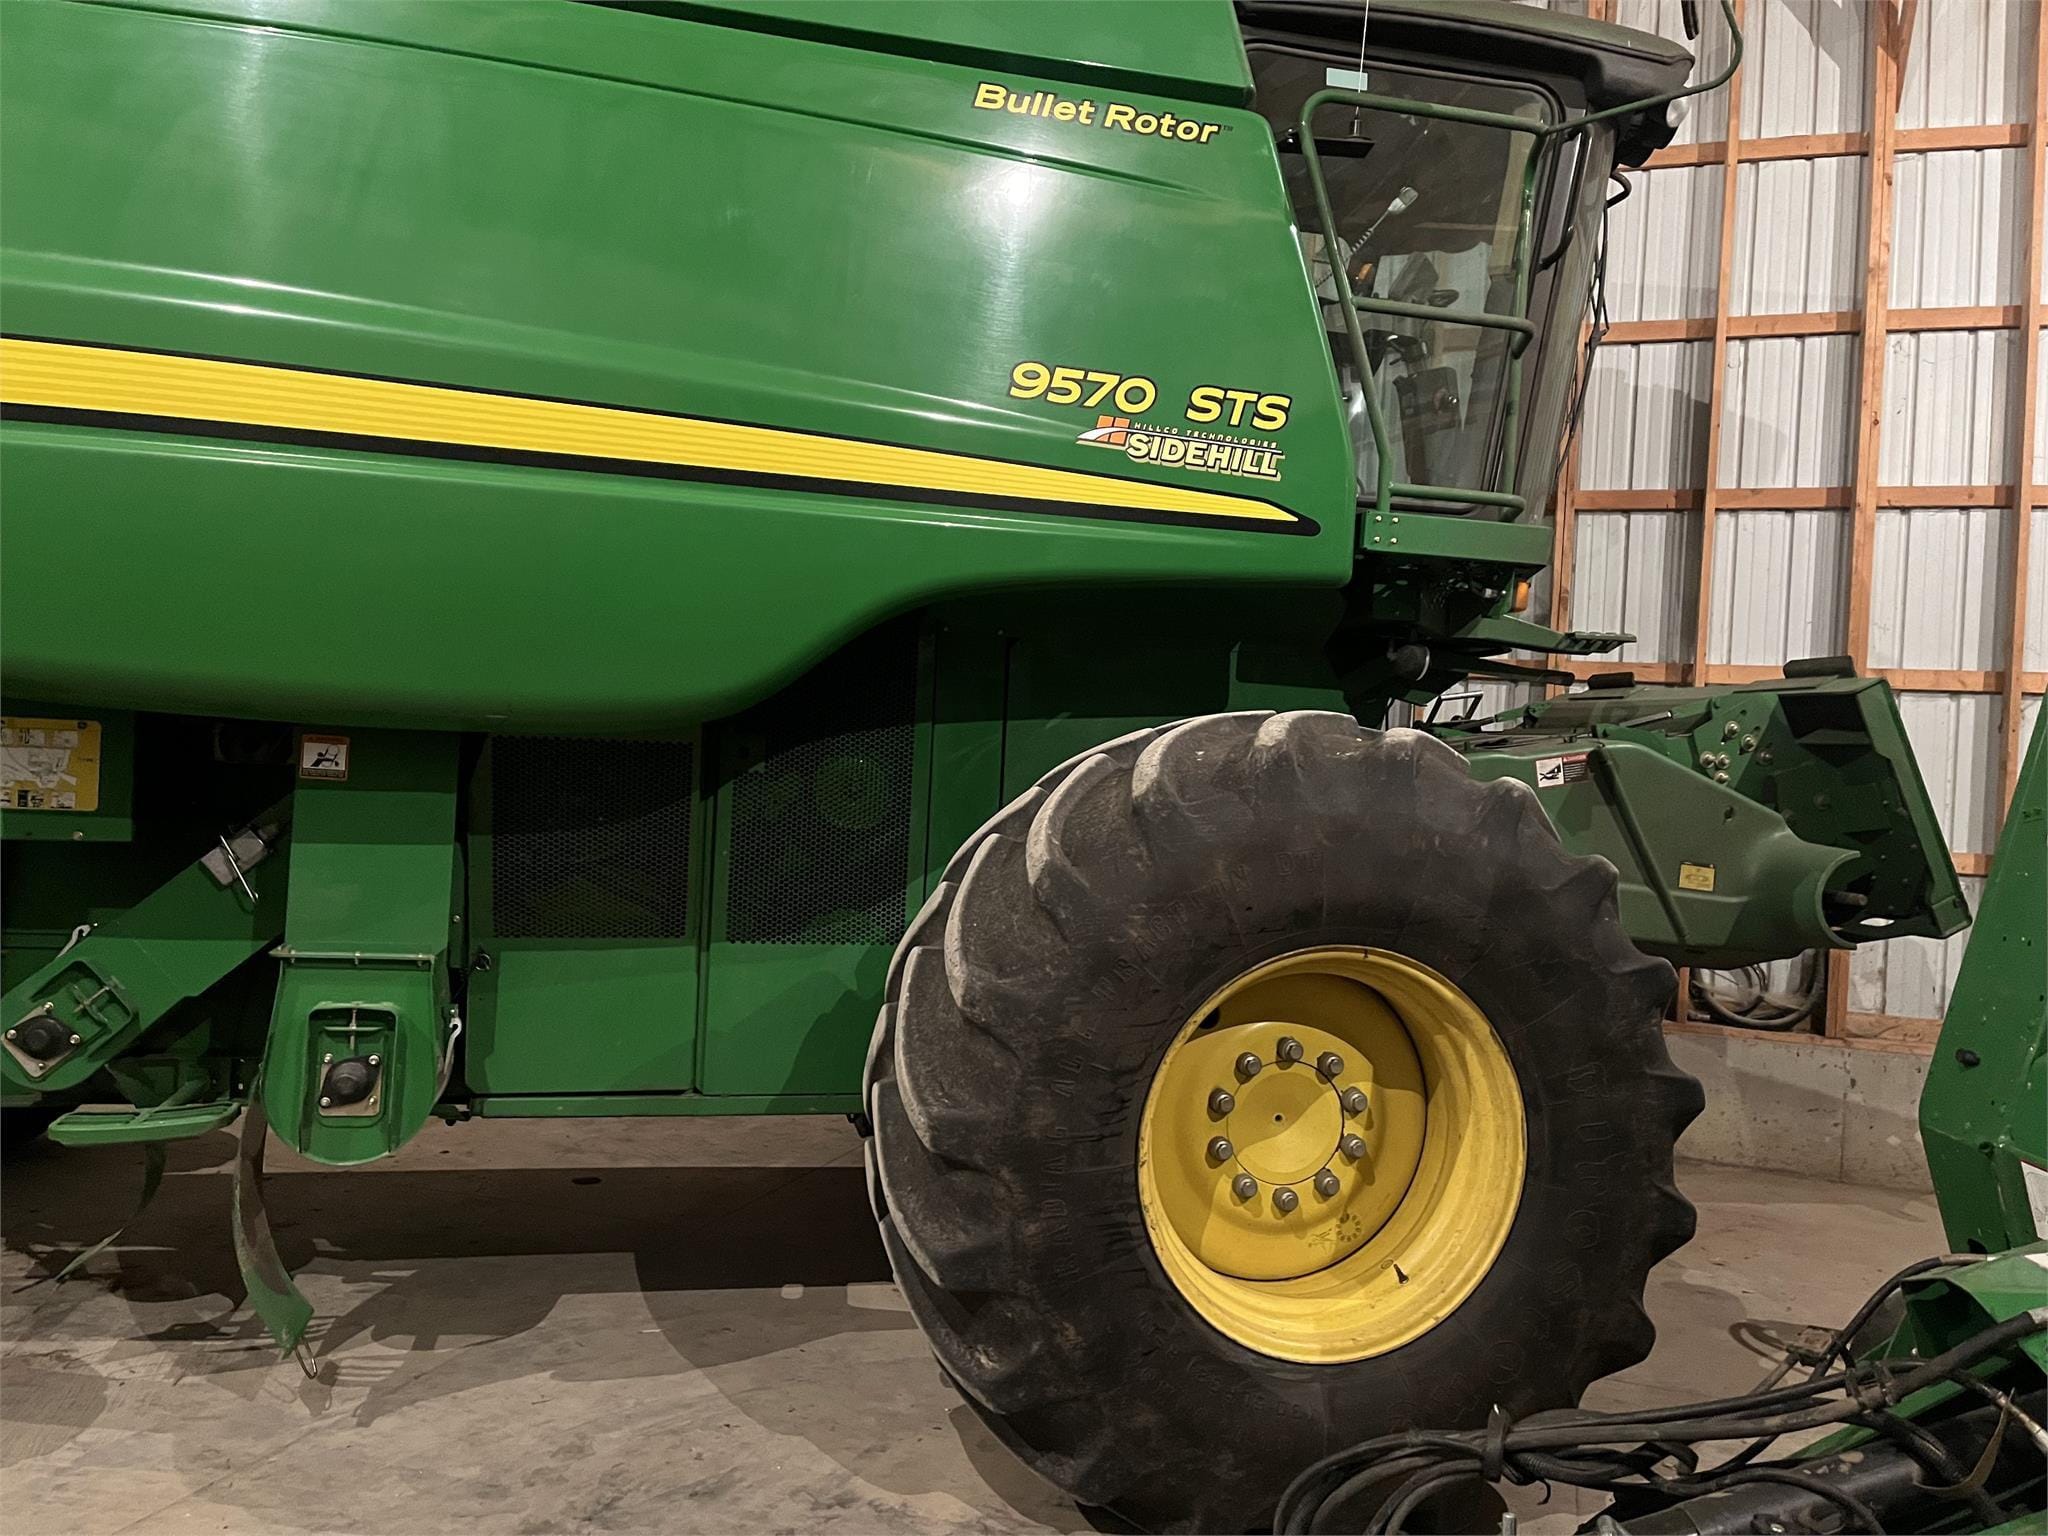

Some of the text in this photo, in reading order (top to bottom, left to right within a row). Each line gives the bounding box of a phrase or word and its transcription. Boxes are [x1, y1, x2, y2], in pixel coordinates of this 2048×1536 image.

[974, 82, 1220, 144] Bullet Rotor
[1009, 361, 1292, 432] 9570 STS
[1127, 433, 1280, 480] SIDEHILL
[1134, 422, 1278, 449] HILLCO TECHNOLOGIES
